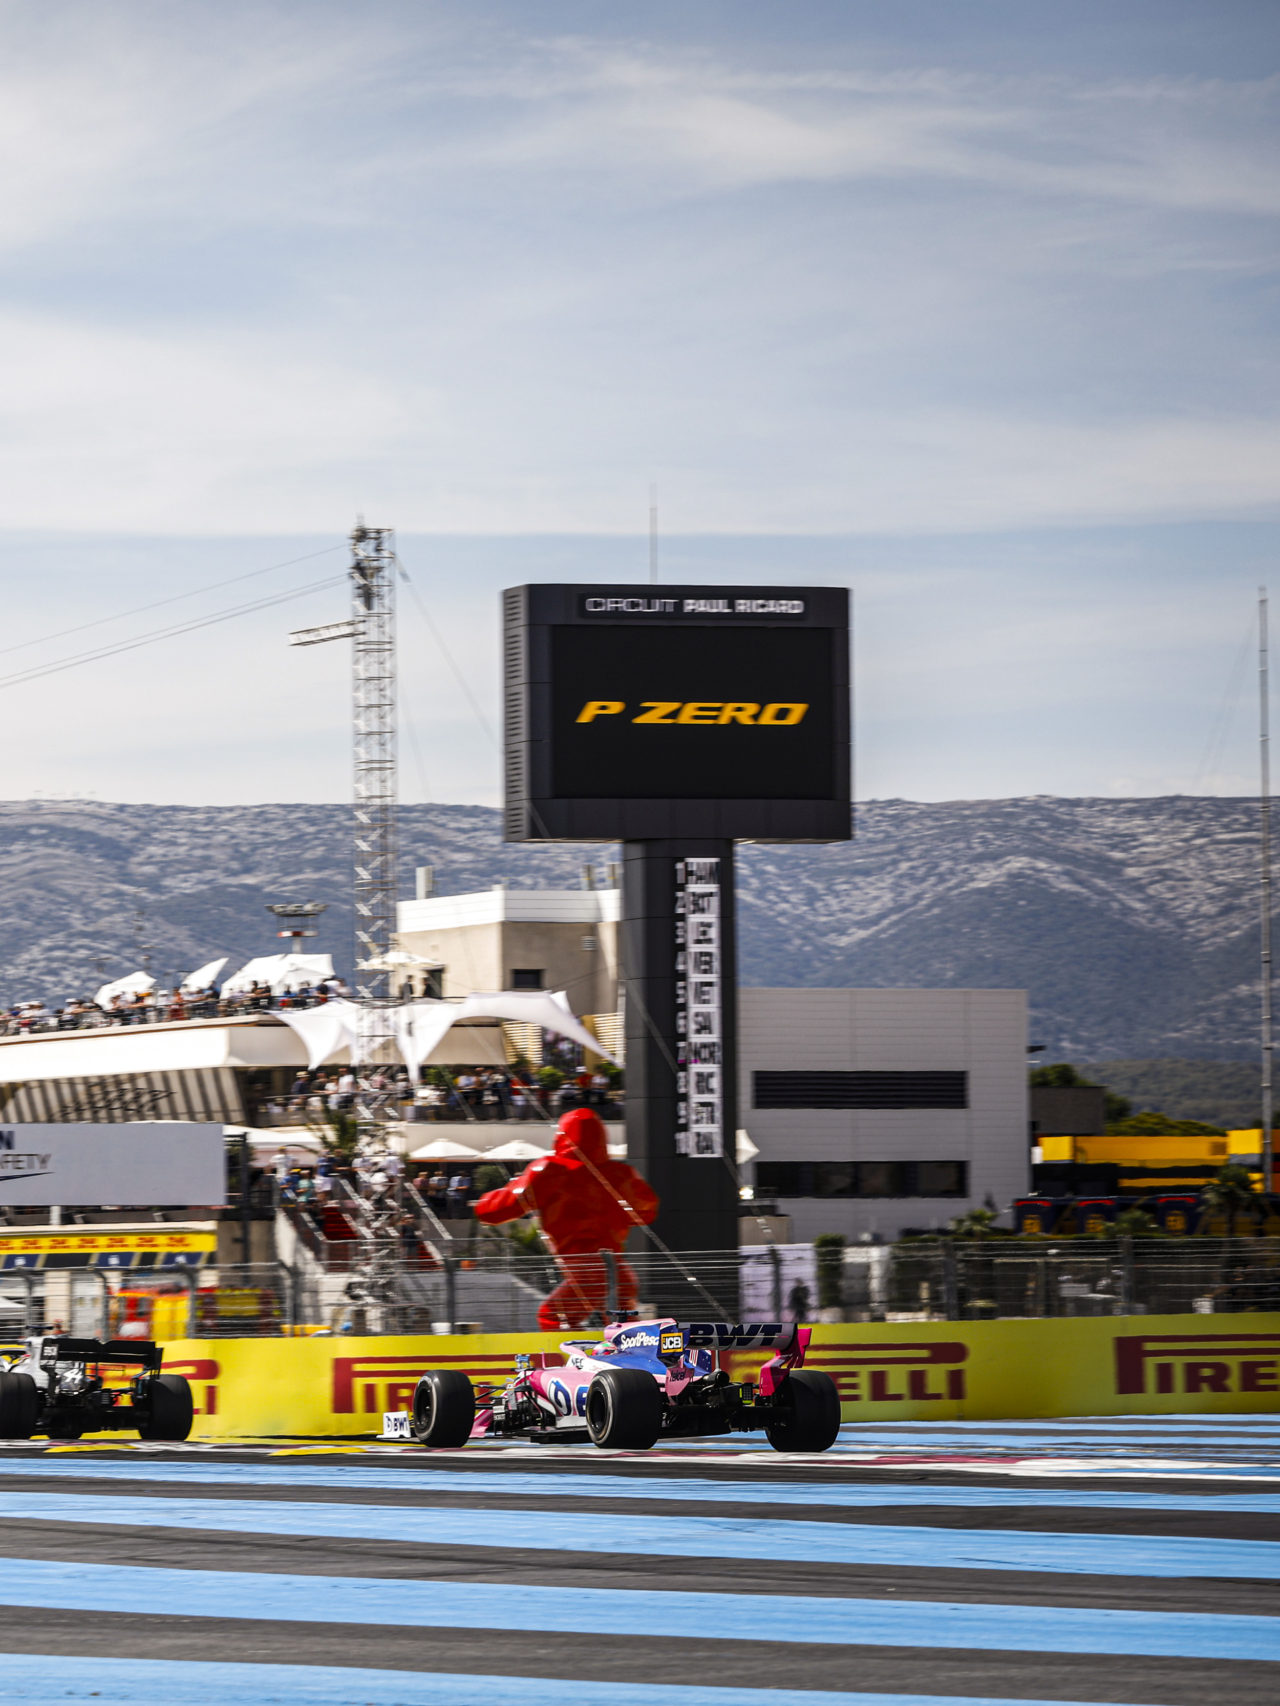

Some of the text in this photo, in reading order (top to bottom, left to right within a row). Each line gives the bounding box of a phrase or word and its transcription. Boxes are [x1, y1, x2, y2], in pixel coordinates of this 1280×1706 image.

[585, 598, 805, 614] CIRCUIT PAUL RICARD
[575, 701, 810, 726] P ZERO
[662, 1336, 682, 1350] JCB
[689, 1323, 783, 1347] BWT
